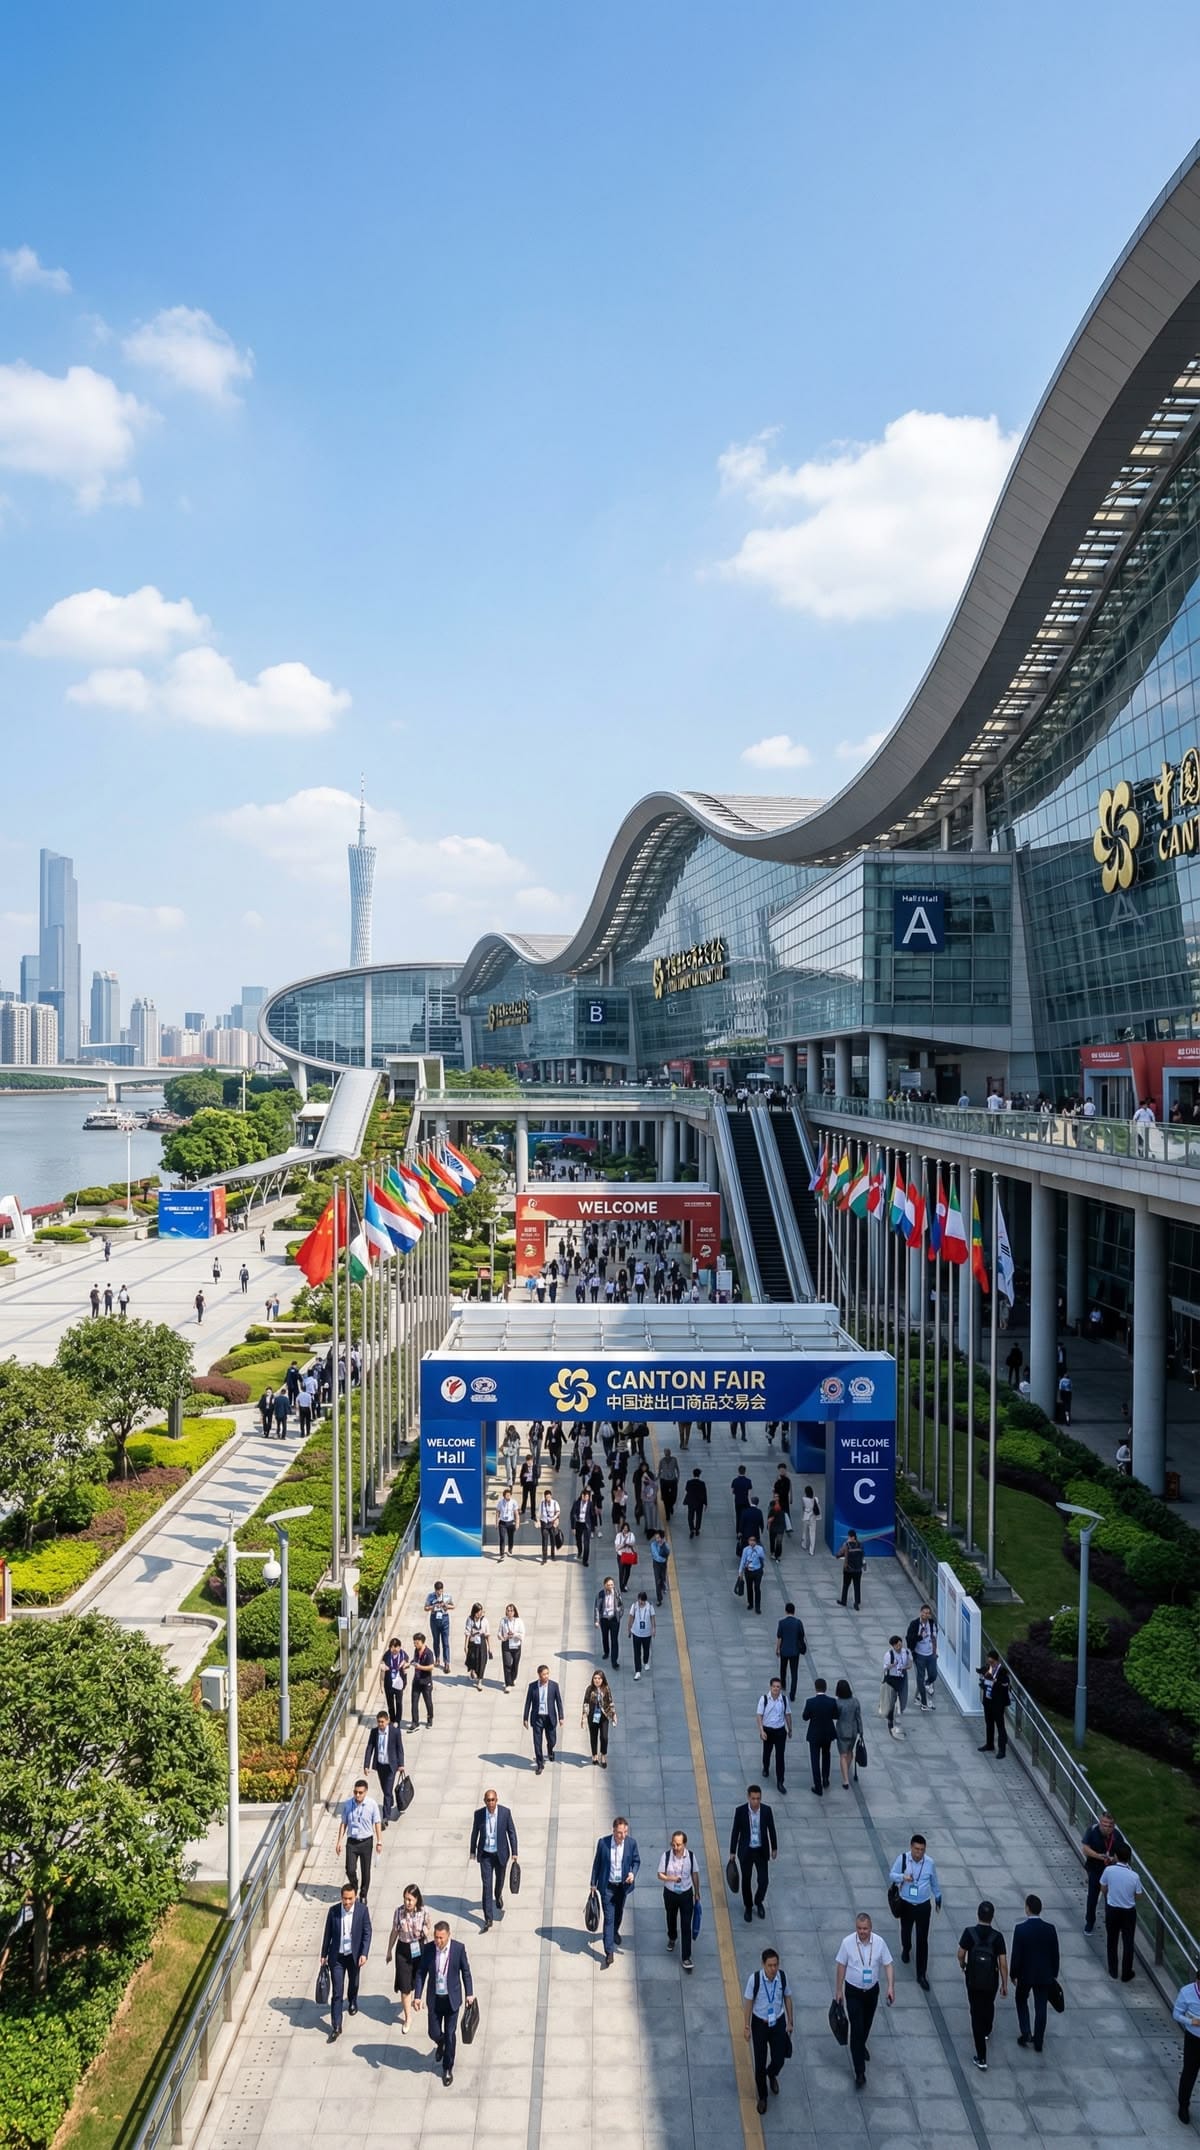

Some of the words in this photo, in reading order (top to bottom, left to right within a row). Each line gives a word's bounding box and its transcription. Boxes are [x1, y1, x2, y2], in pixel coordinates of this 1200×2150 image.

[902, 907, 937, 944] A
[590, 1006, 603, 1022] B
[578, 1201, 658, 1214] WELCOME
[607, 1370, 706, 1390] CANTON
[713, 1370, 766, 1390] FAIR
[606, 1394, 767, 1411] 中国进出口商品交易会
[427, 1438, 476, 1447] WELCOME
[841, 1438, 890, 1448] WELCOME
[437, 1451, 465, 1464] Hall
[851, 1451, 879, 1464] Hall
[438, 1478, 463, 1504] A
[853, 1478, 876, 1504] C
